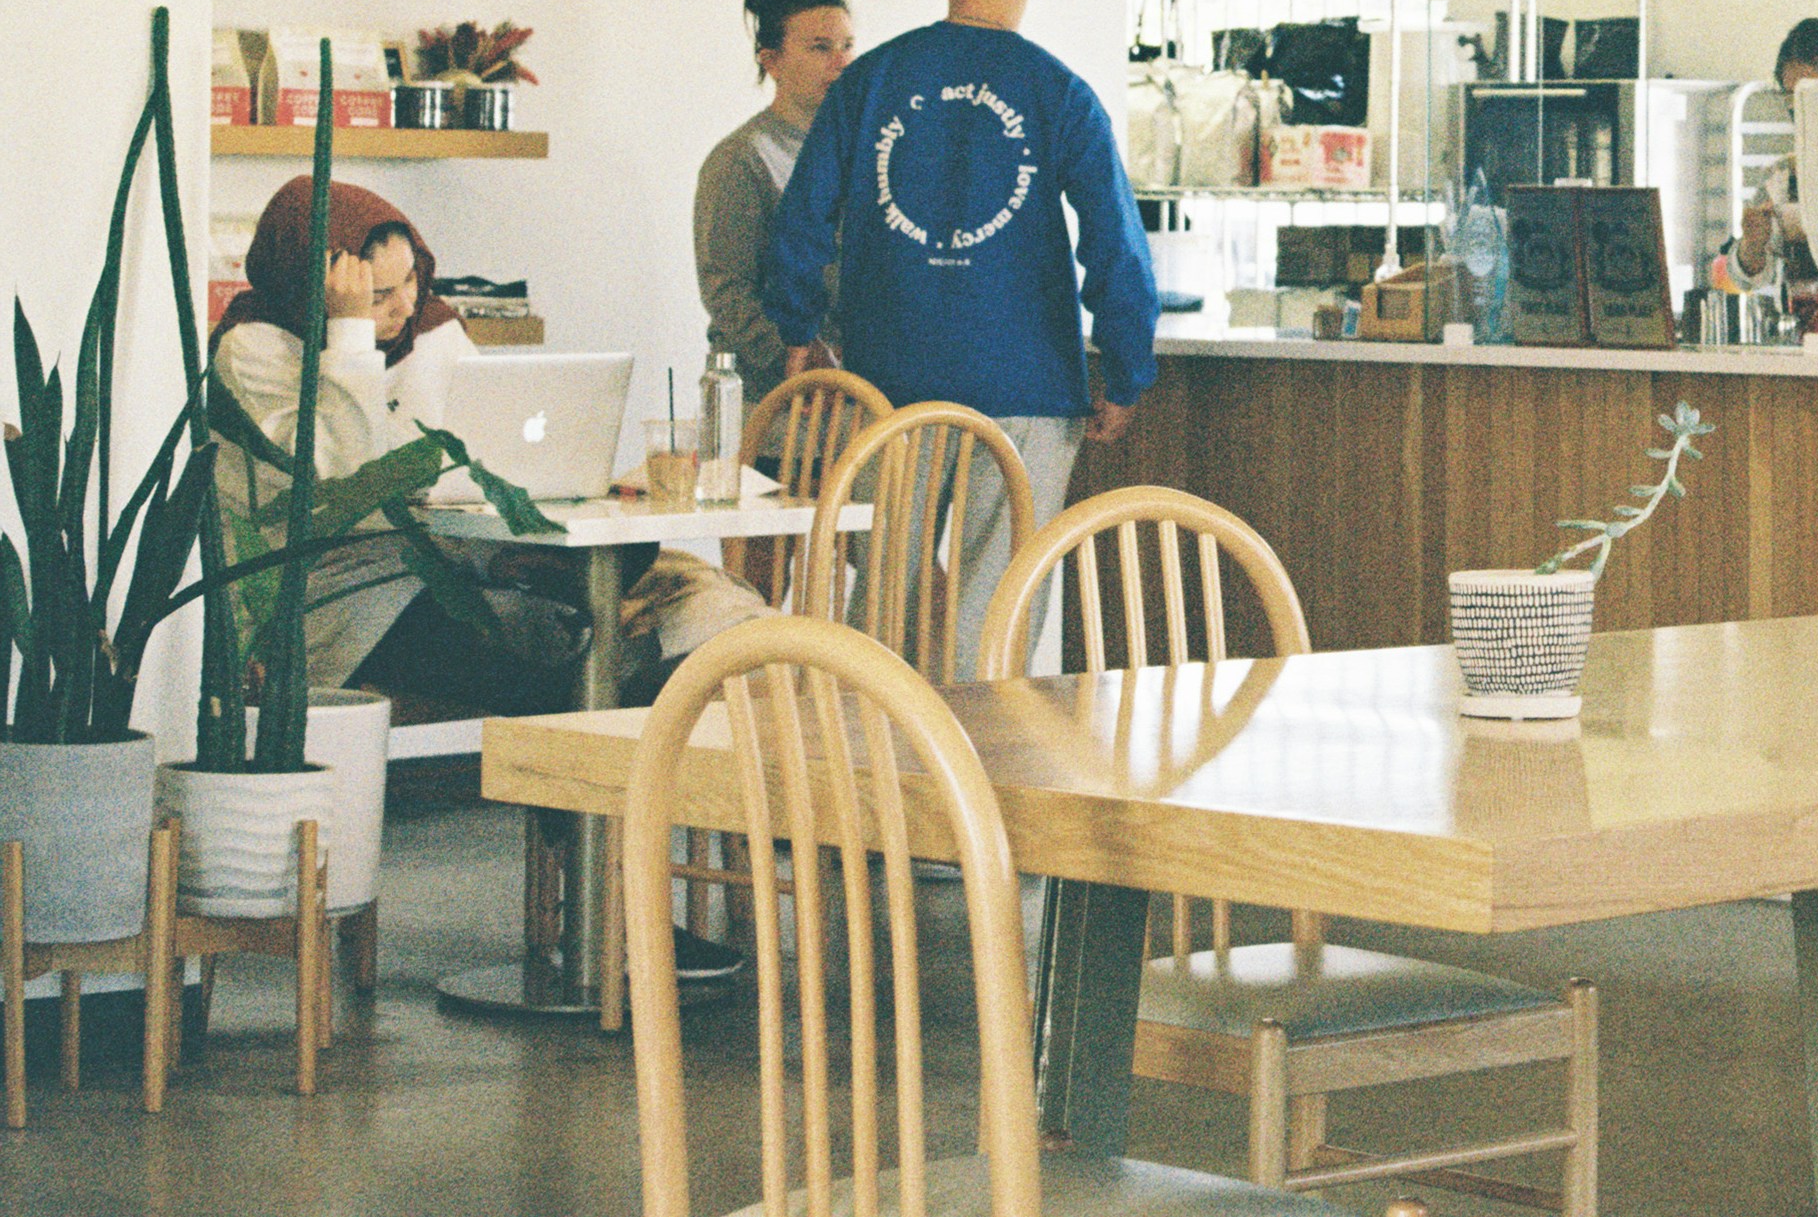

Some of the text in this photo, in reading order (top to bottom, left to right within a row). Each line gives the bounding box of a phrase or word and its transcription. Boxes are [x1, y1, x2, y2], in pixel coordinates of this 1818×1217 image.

[875, 83, 1038, 249] act justly love mercy walk humbly
